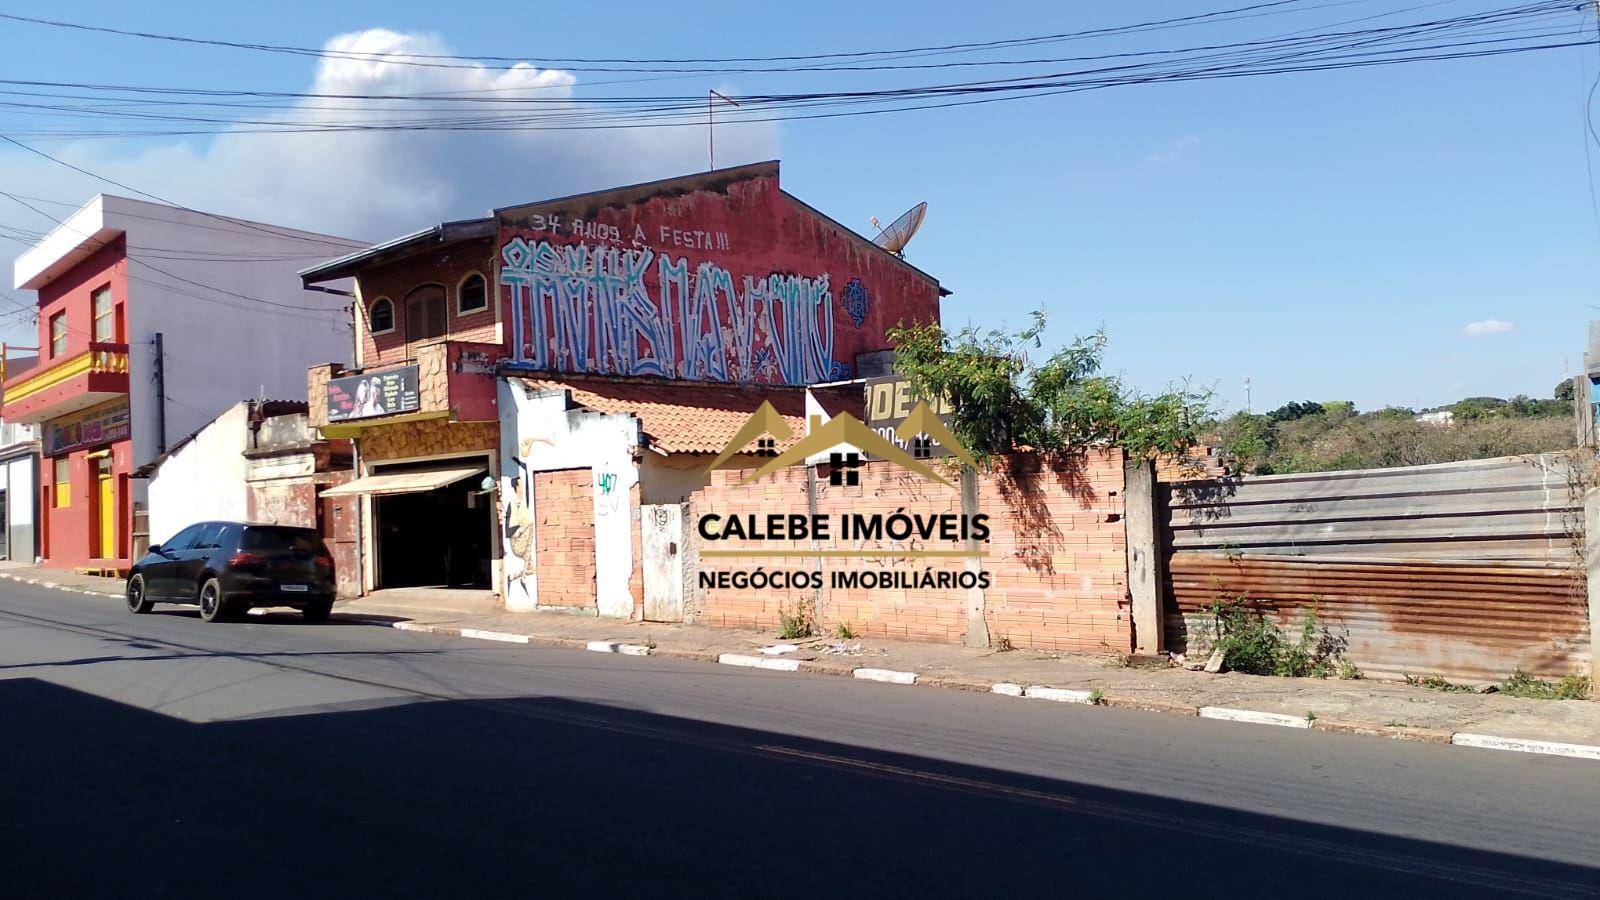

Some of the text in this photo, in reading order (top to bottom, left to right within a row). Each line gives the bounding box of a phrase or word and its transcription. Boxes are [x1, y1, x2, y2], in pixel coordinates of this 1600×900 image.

[531, 214, 562, 235] 34
[634, 223, 647, 241] A
[660, 225, 731, 251] FESTA!!!
